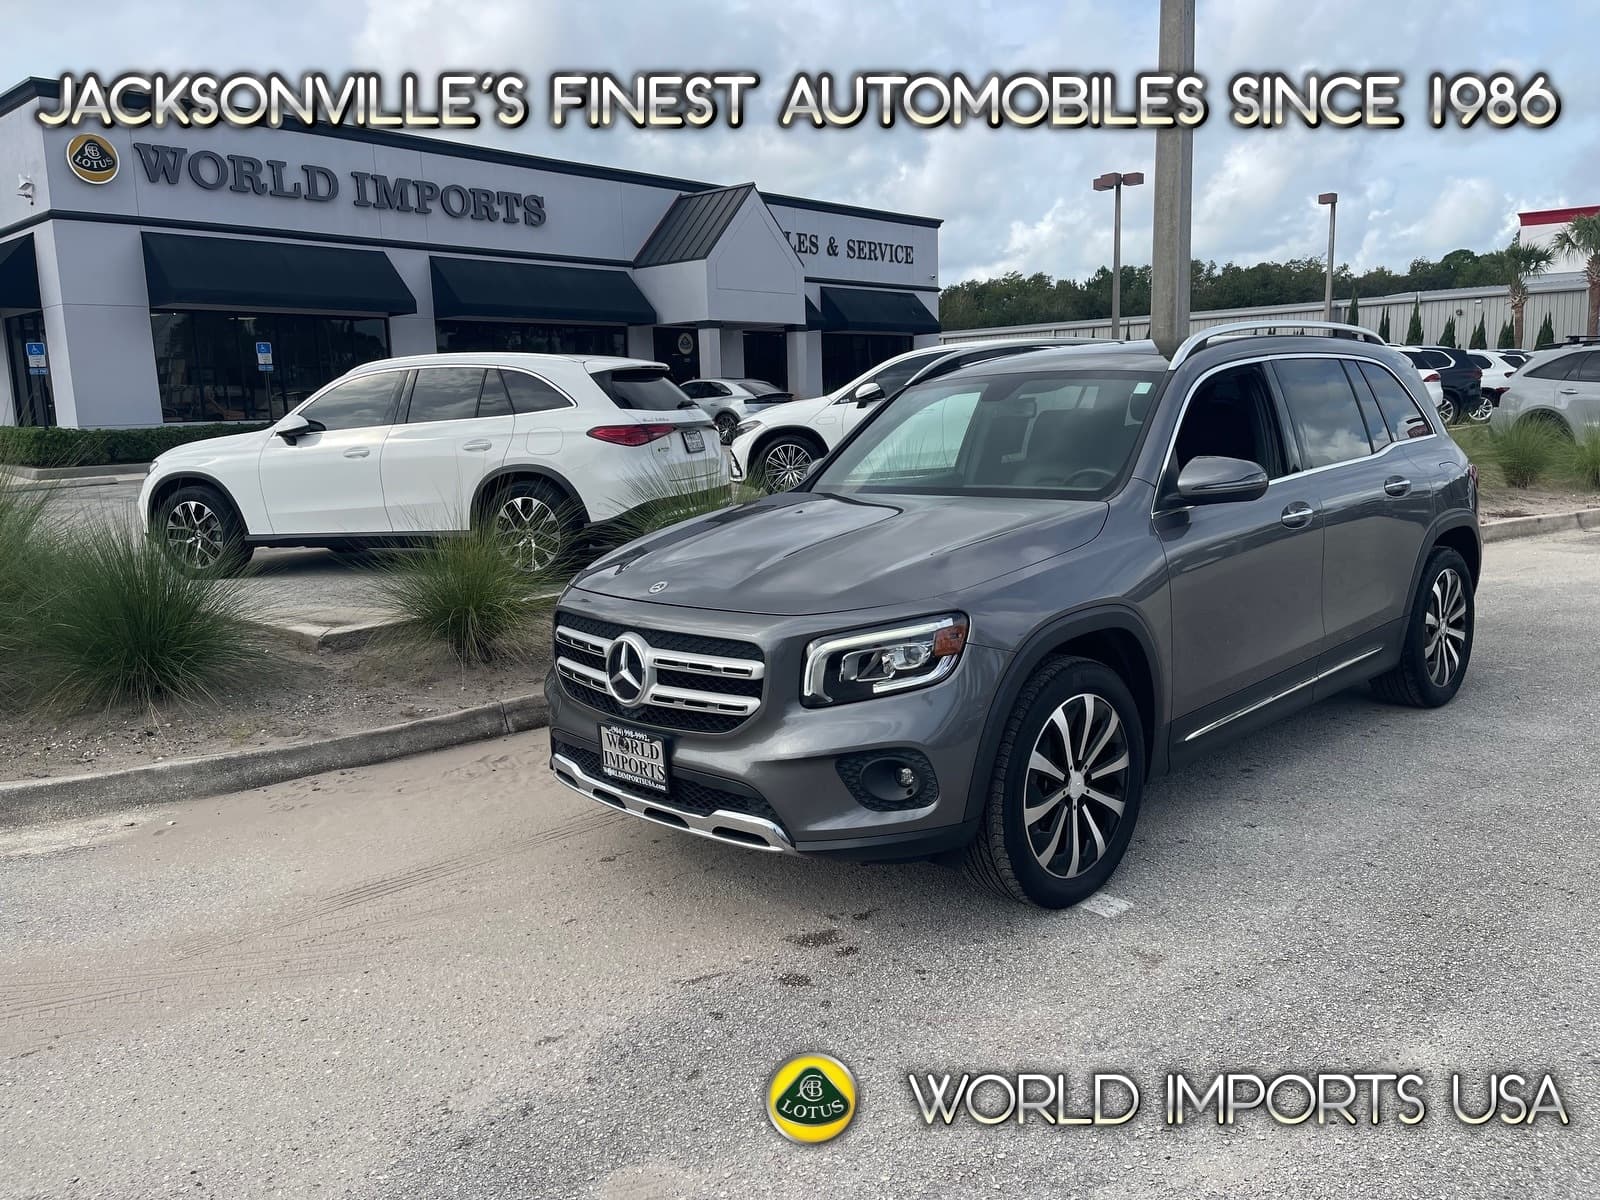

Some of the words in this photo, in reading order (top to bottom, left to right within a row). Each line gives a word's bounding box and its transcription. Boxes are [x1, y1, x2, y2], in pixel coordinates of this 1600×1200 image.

[74, 155, 114, 169] LOTUS
[133, 143, 340, 202] WORLD
[350, 170, 547, 228] IMPORTS
[826, 236, 839, 257] &
[846, 239, 914, 265] SERVICE
[604, 750, 666, 781] IMPORTS
